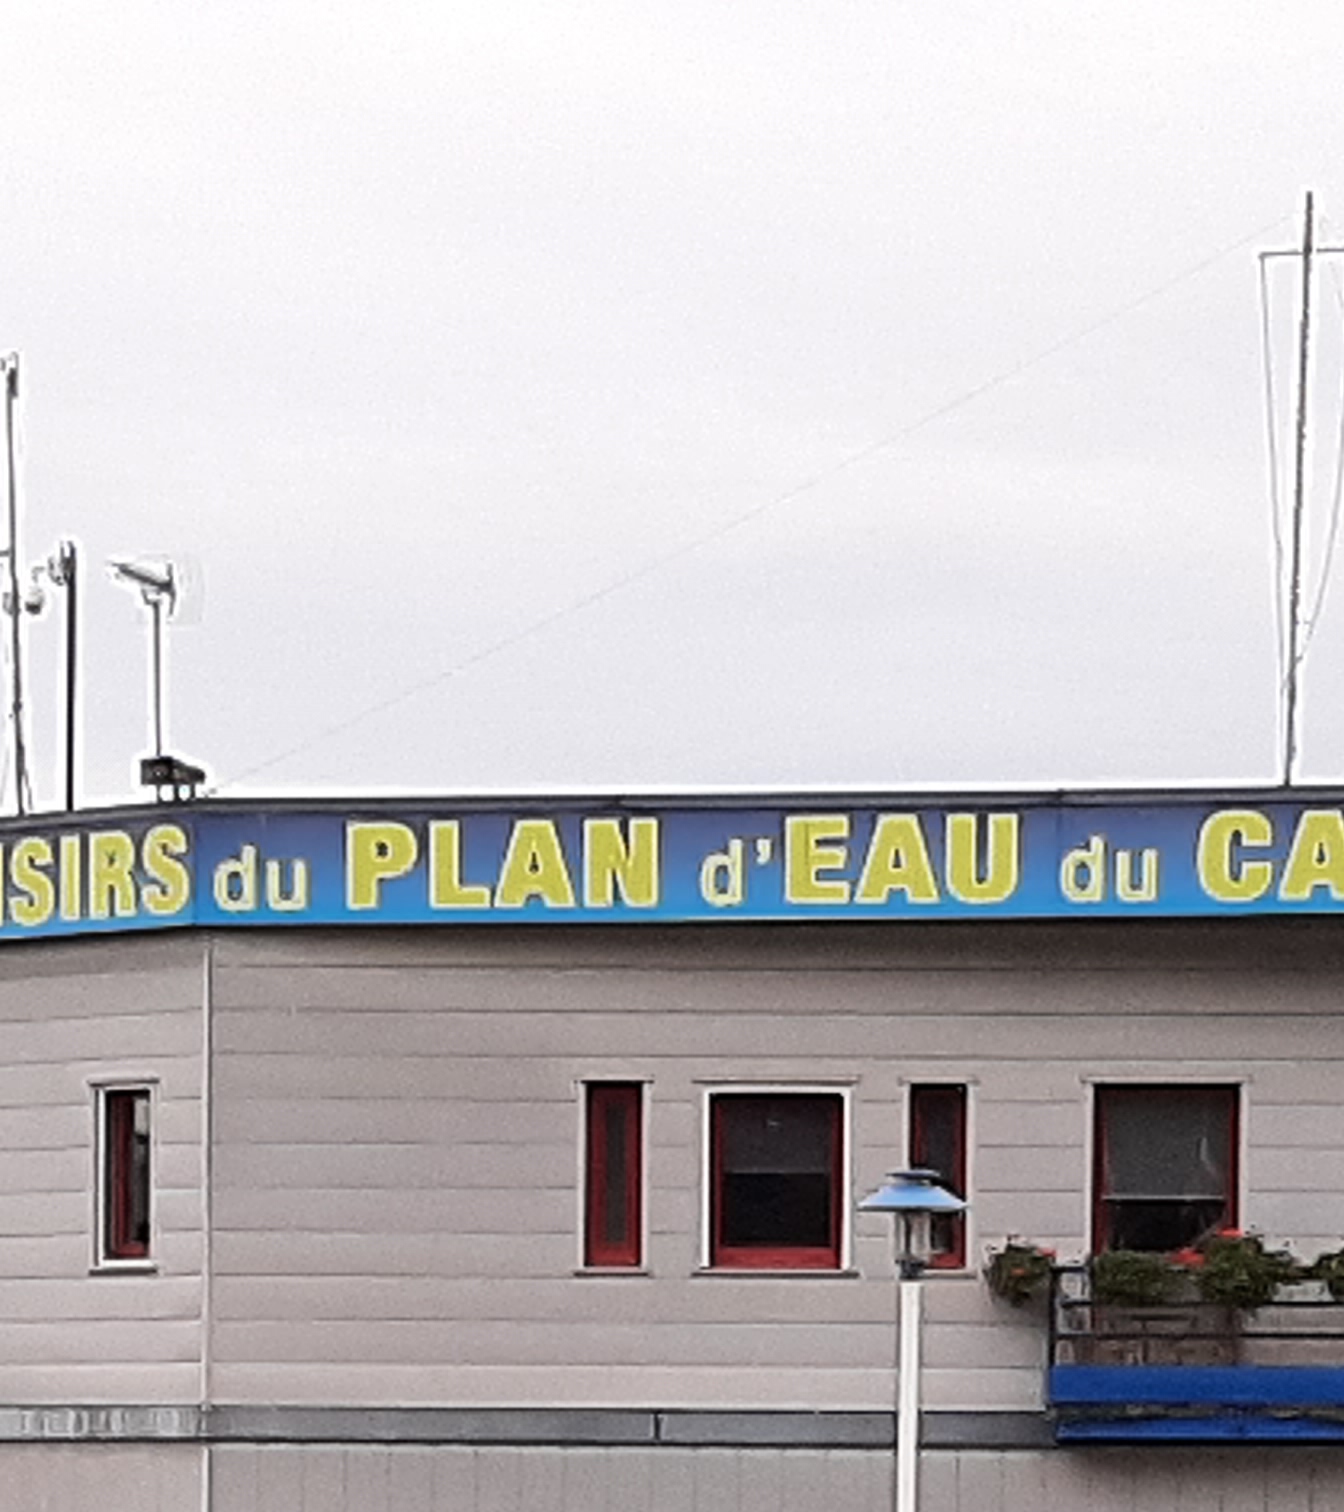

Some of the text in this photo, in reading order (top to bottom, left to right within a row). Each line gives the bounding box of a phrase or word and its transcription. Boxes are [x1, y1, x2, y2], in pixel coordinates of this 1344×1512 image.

[212, 844, 309, 913] du
[345, 818, 659, 910] PLAN
[699, 813, 1020, 906] d'EAU
[1060, 835, 1159, 903] du
